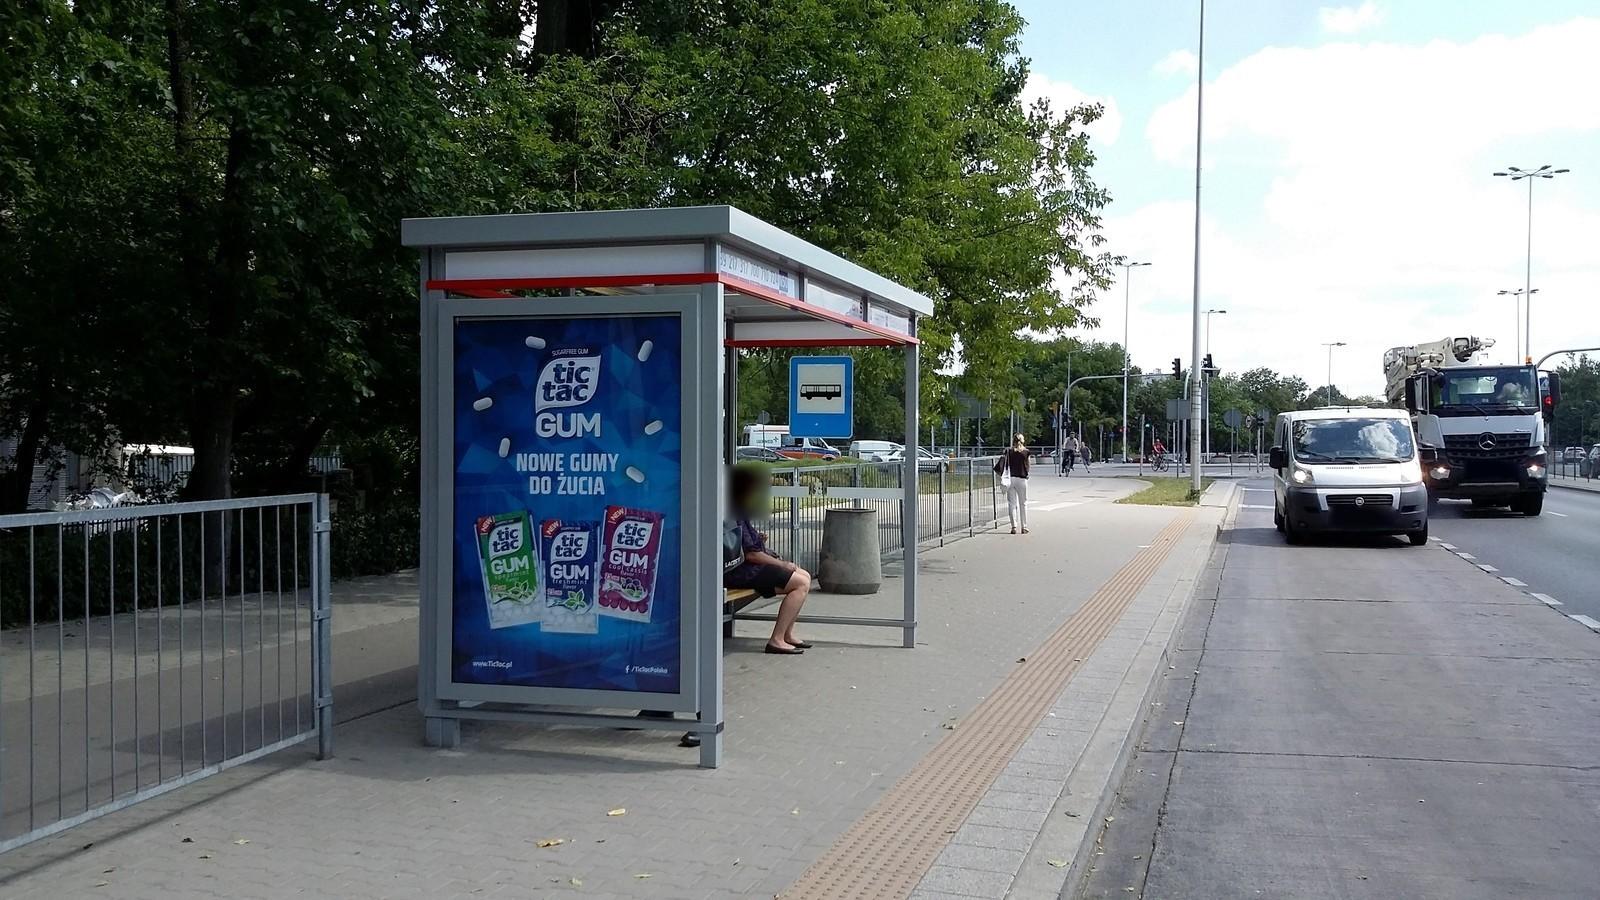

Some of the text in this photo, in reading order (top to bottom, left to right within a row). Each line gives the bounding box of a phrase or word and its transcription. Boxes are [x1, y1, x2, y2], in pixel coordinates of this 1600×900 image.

[551, 347, 589, 357] SUGARFREE GUM
[552, 360, 591, 384] tic
[542, 381, 589, 402] tac
[535, 412, 601, 438] GUM
[516, 453, 620, 472] NOWE GUMY
[529, 472, 606, 495] DO ŻUCIA
[496, 527, 519, 541] tic
[624, 523, 647, 537] tic
[492, 539, 519, 553] tac
[561, 533, 584, 547] tic
[616, 532, 645, 547] tac
[555, 544, 583, 558] tac
[610, 549, 649, 570] GUM
[490, 555, 530, 574] GUM
[550, 563, 590, 580] GUM
